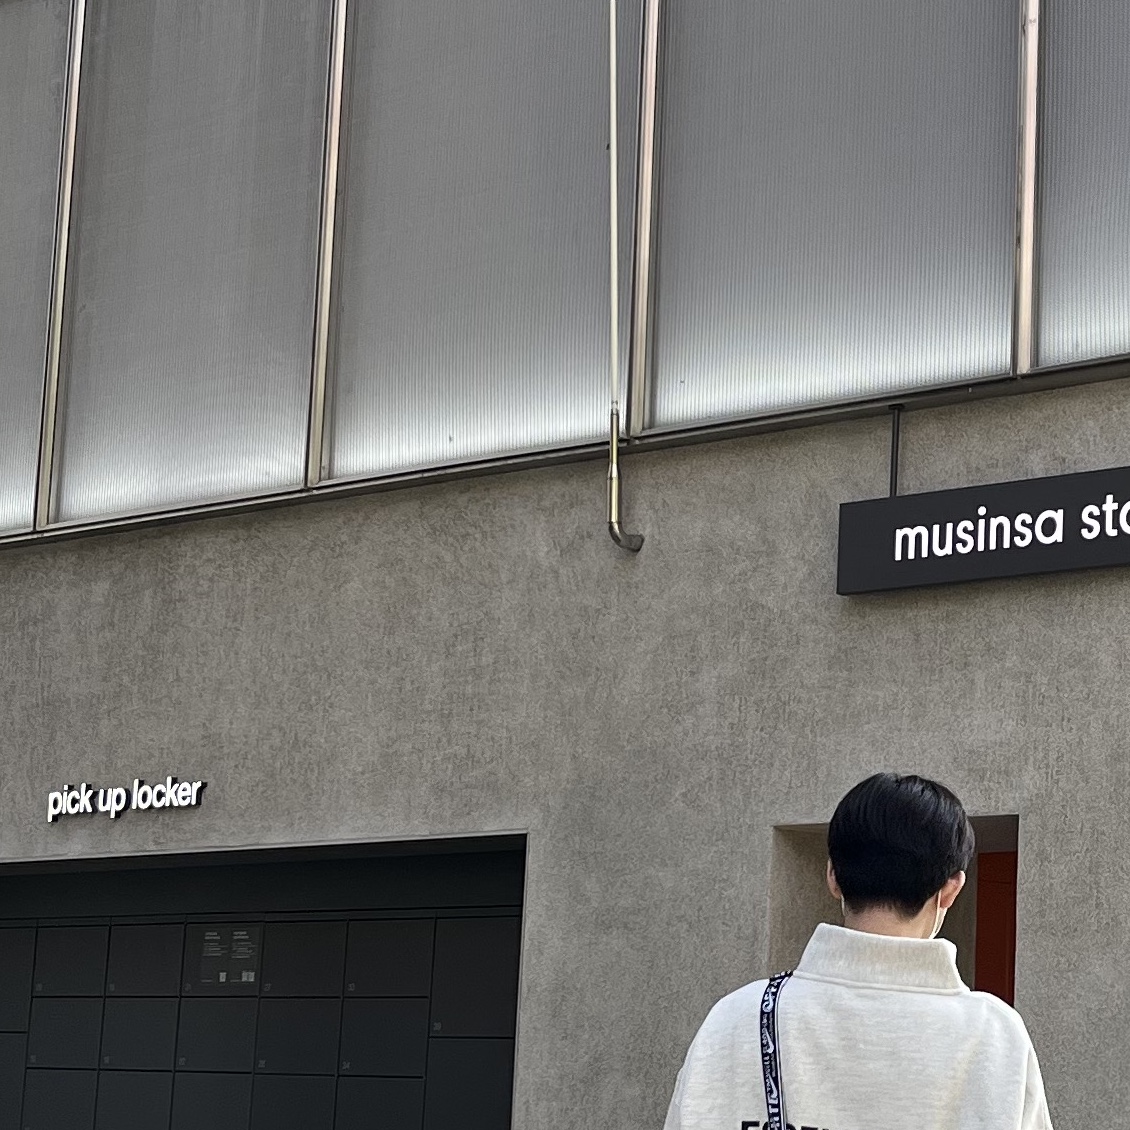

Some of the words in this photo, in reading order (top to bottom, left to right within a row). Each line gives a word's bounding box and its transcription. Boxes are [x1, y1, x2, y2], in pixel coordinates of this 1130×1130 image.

[894, 505, 1064, 561] musinsa
[47, 782, 94, 823] pick
[98, 787, 127, 819] up
[131, 775, 202, 811] locker
